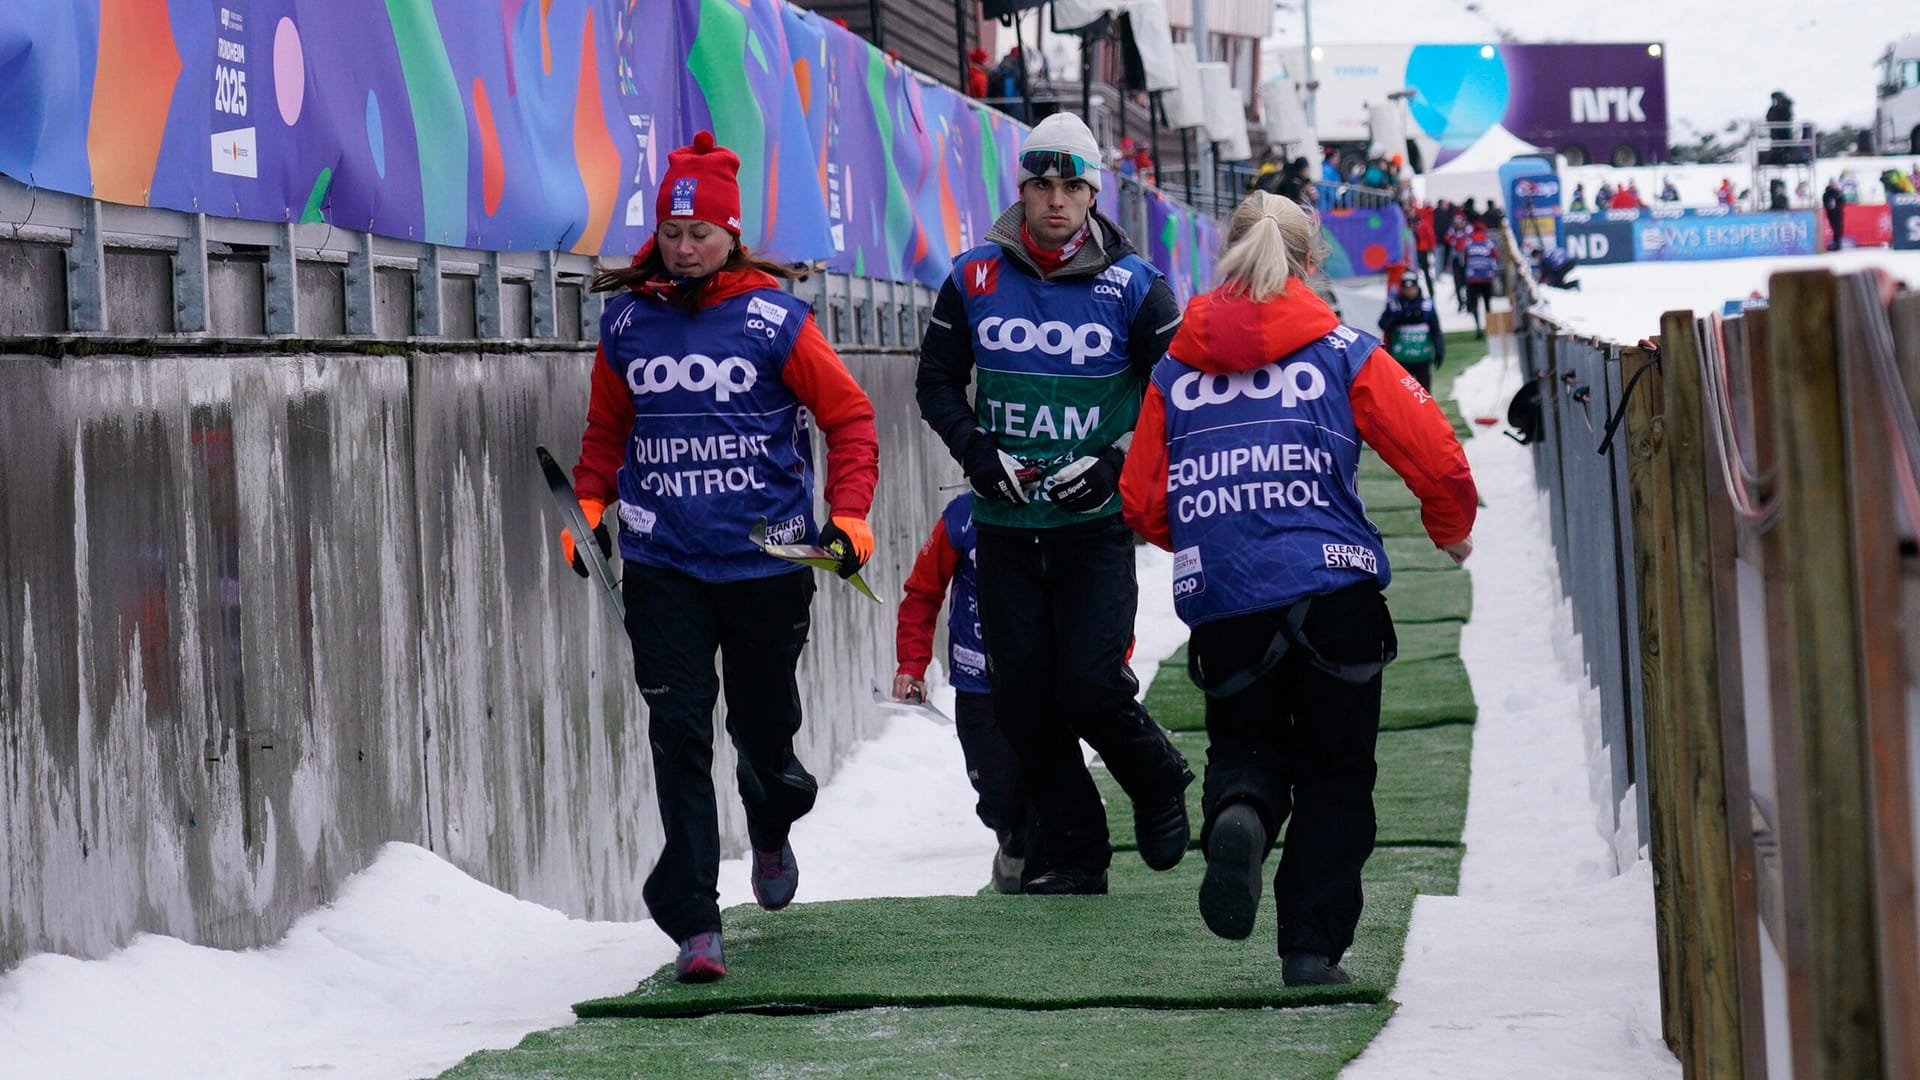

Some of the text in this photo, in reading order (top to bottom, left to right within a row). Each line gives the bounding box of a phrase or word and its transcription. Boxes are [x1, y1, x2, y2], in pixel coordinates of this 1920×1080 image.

[215, 64, 248, 117] 2025
[1570, 86, 1646, 123] NRK
[1664, 218, 1808, 247] VVS EKSPERTEN
[977, 316, 1113, 365] coop
[626, 354, 758, 402] coop
[1171, 361, 1326, 411] coop
[987, 398, 1100, 440] TEAM
[634, 434, 772, 465] QUIPMENT
[1178, 480, 1330, 523] CONTROL
[766, 521, 791, 536] LEAN
[1325, 544, 1361, 556] CLEAN
